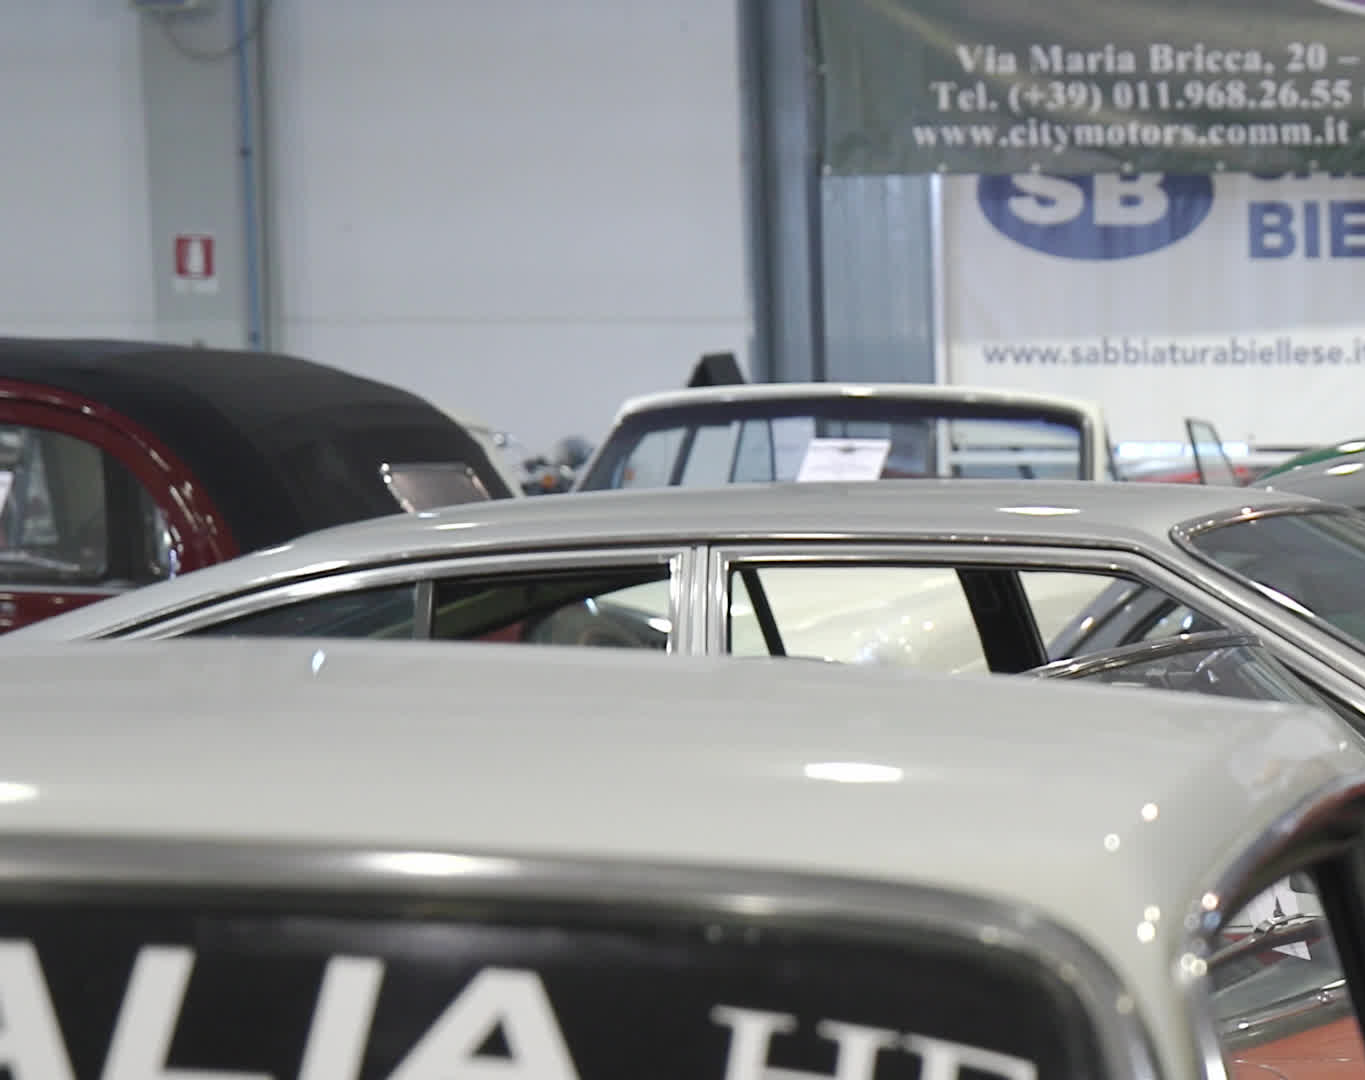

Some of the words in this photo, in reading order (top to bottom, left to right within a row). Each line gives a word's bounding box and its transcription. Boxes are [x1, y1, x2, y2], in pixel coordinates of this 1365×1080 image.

[956, 45, 1017, 74] Via
[1031, 44, 1136, 73] Maria
[1150, 43, 1273, 76] Bricca,
[1287, 42, 1327, 71] 20
[930, 82, 997, 111] Tel.
[1010, 82, 1101, 114] (+39)
[1114, 80, 1352, 110] 011.968.26.55
[912, 117, 1350, 153] www.citymotors.comm.it
[1007, 172, 1169, 226] SB
